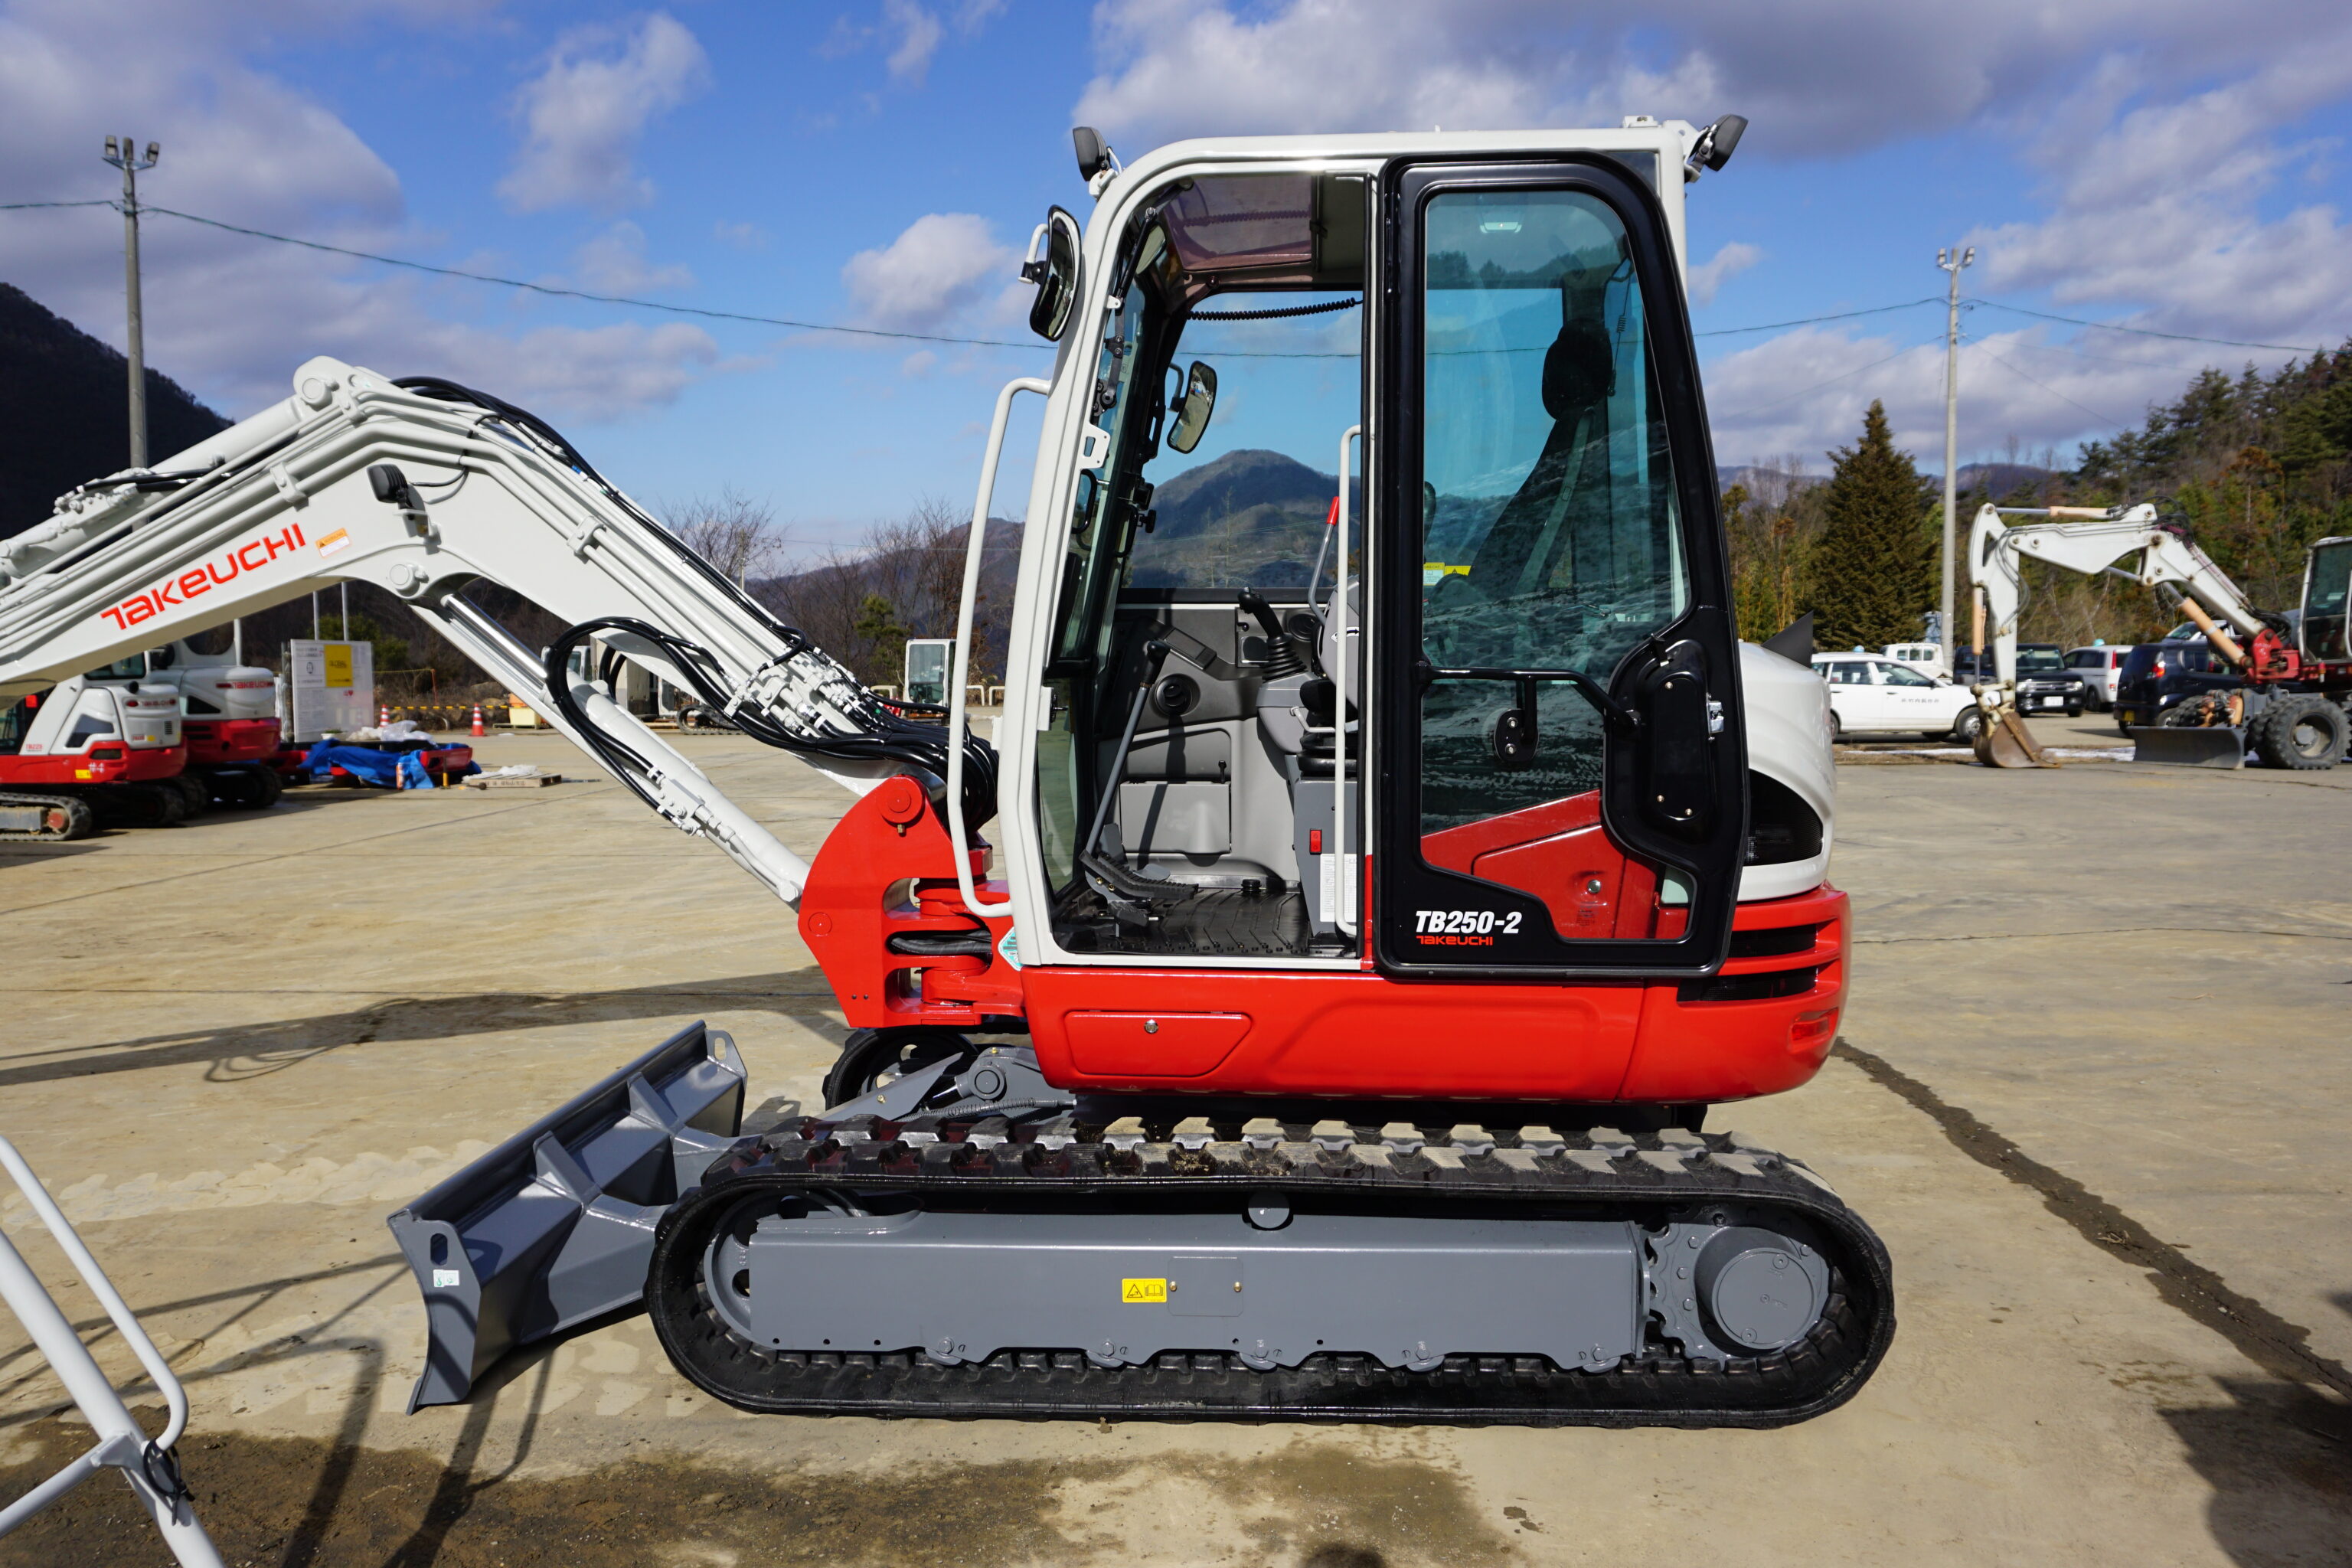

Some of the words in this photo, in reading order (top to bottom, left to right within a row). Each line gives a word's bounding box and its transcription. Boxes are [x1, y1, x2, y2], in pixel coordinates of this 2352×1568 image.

[100, 523, 306, 630] TAKEUCHI
[1416, 910, 1523, 934] TB250-2
[1416, 935, 1493, 946] TAKEUCHI
